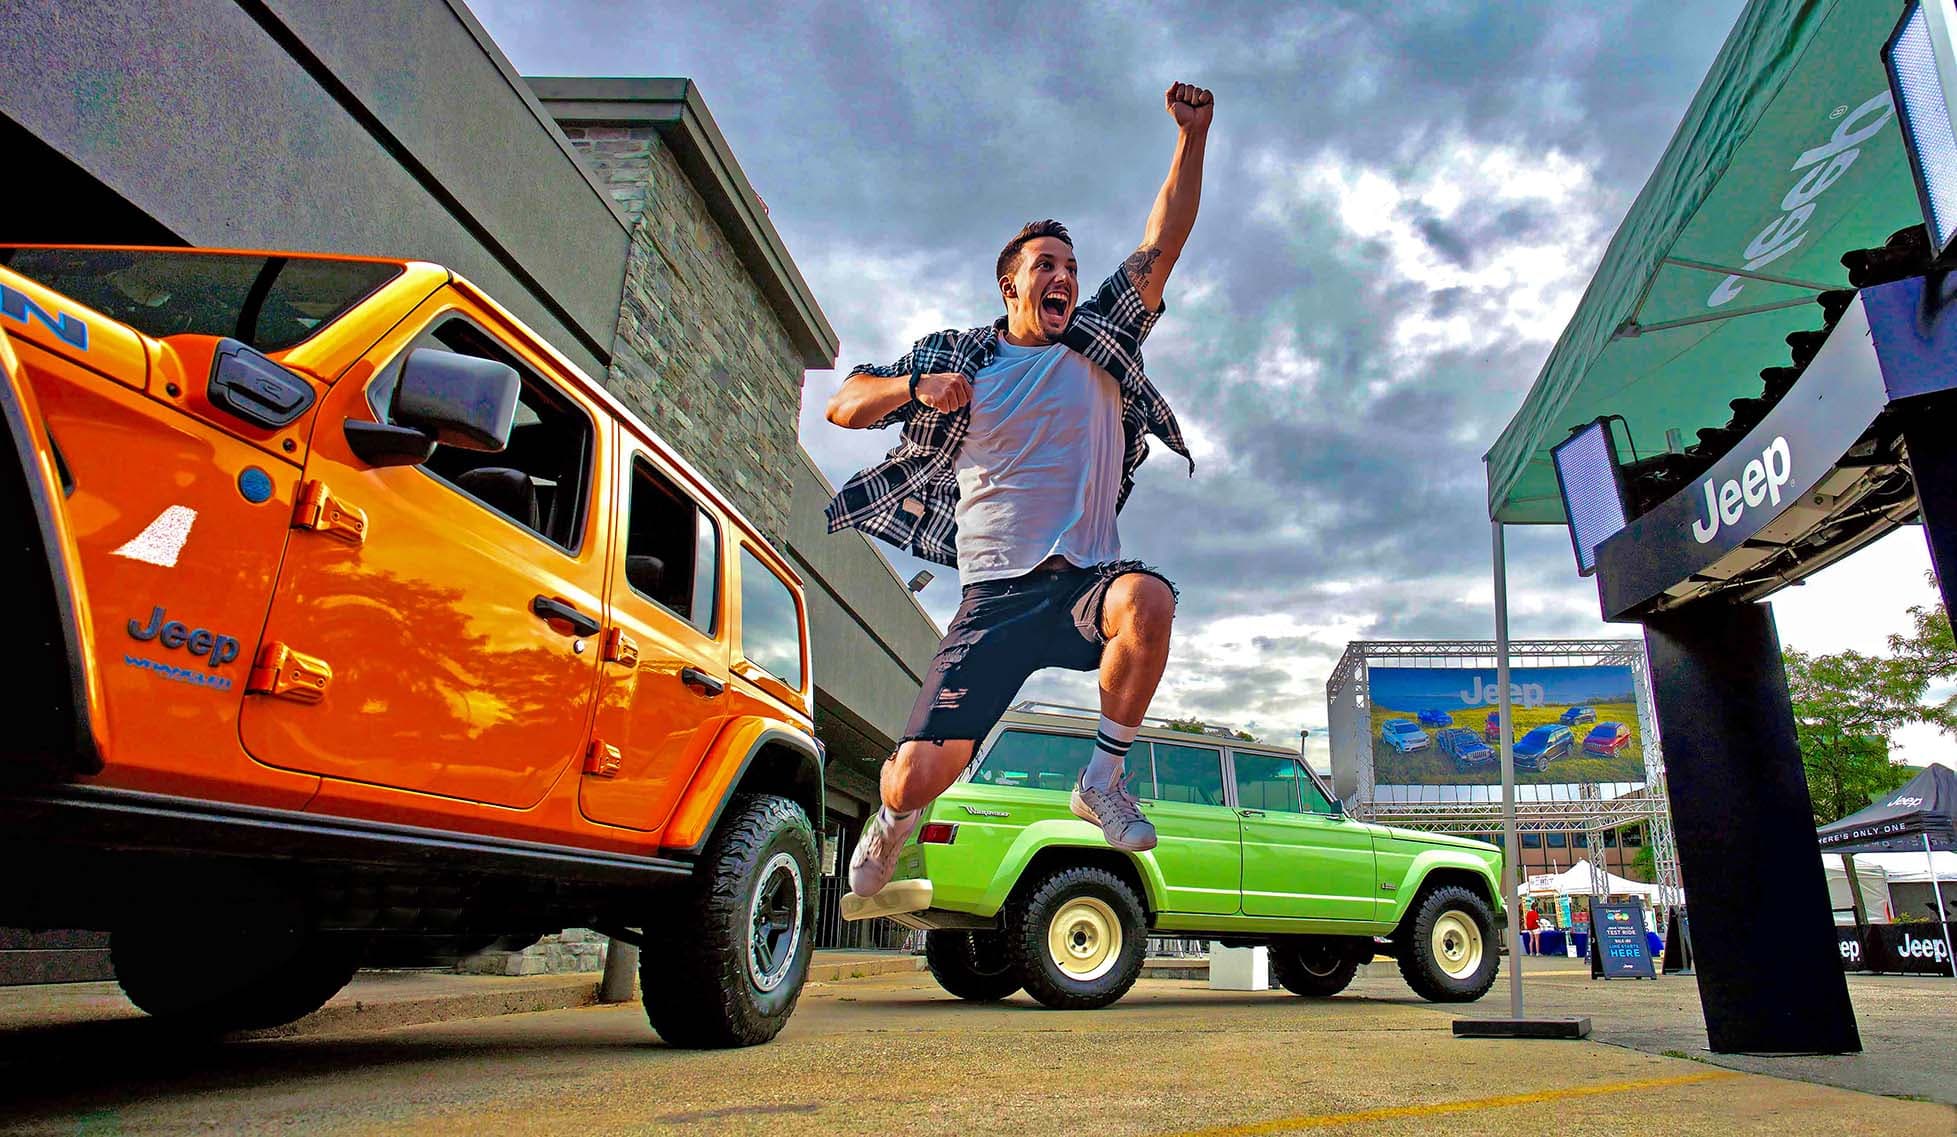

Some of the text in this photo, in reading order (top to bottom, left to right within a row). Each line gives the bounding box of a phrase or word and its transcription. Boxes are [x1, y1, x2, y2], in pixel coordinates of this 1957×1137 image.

[1692, 436, 1791, 544] Jeep
[127, 606, 240, 667] Jeep
[1460, 676, 1544, 710] Jeep
[1887, 795, 1922, 807] Jeep
[1853, 828, 1879, 838] ONLY
[1884, 823, 1906, 833] ONE
[1610, 949, 1641, 957] HERE
[1897, 933, 1947, 962] Jeep
